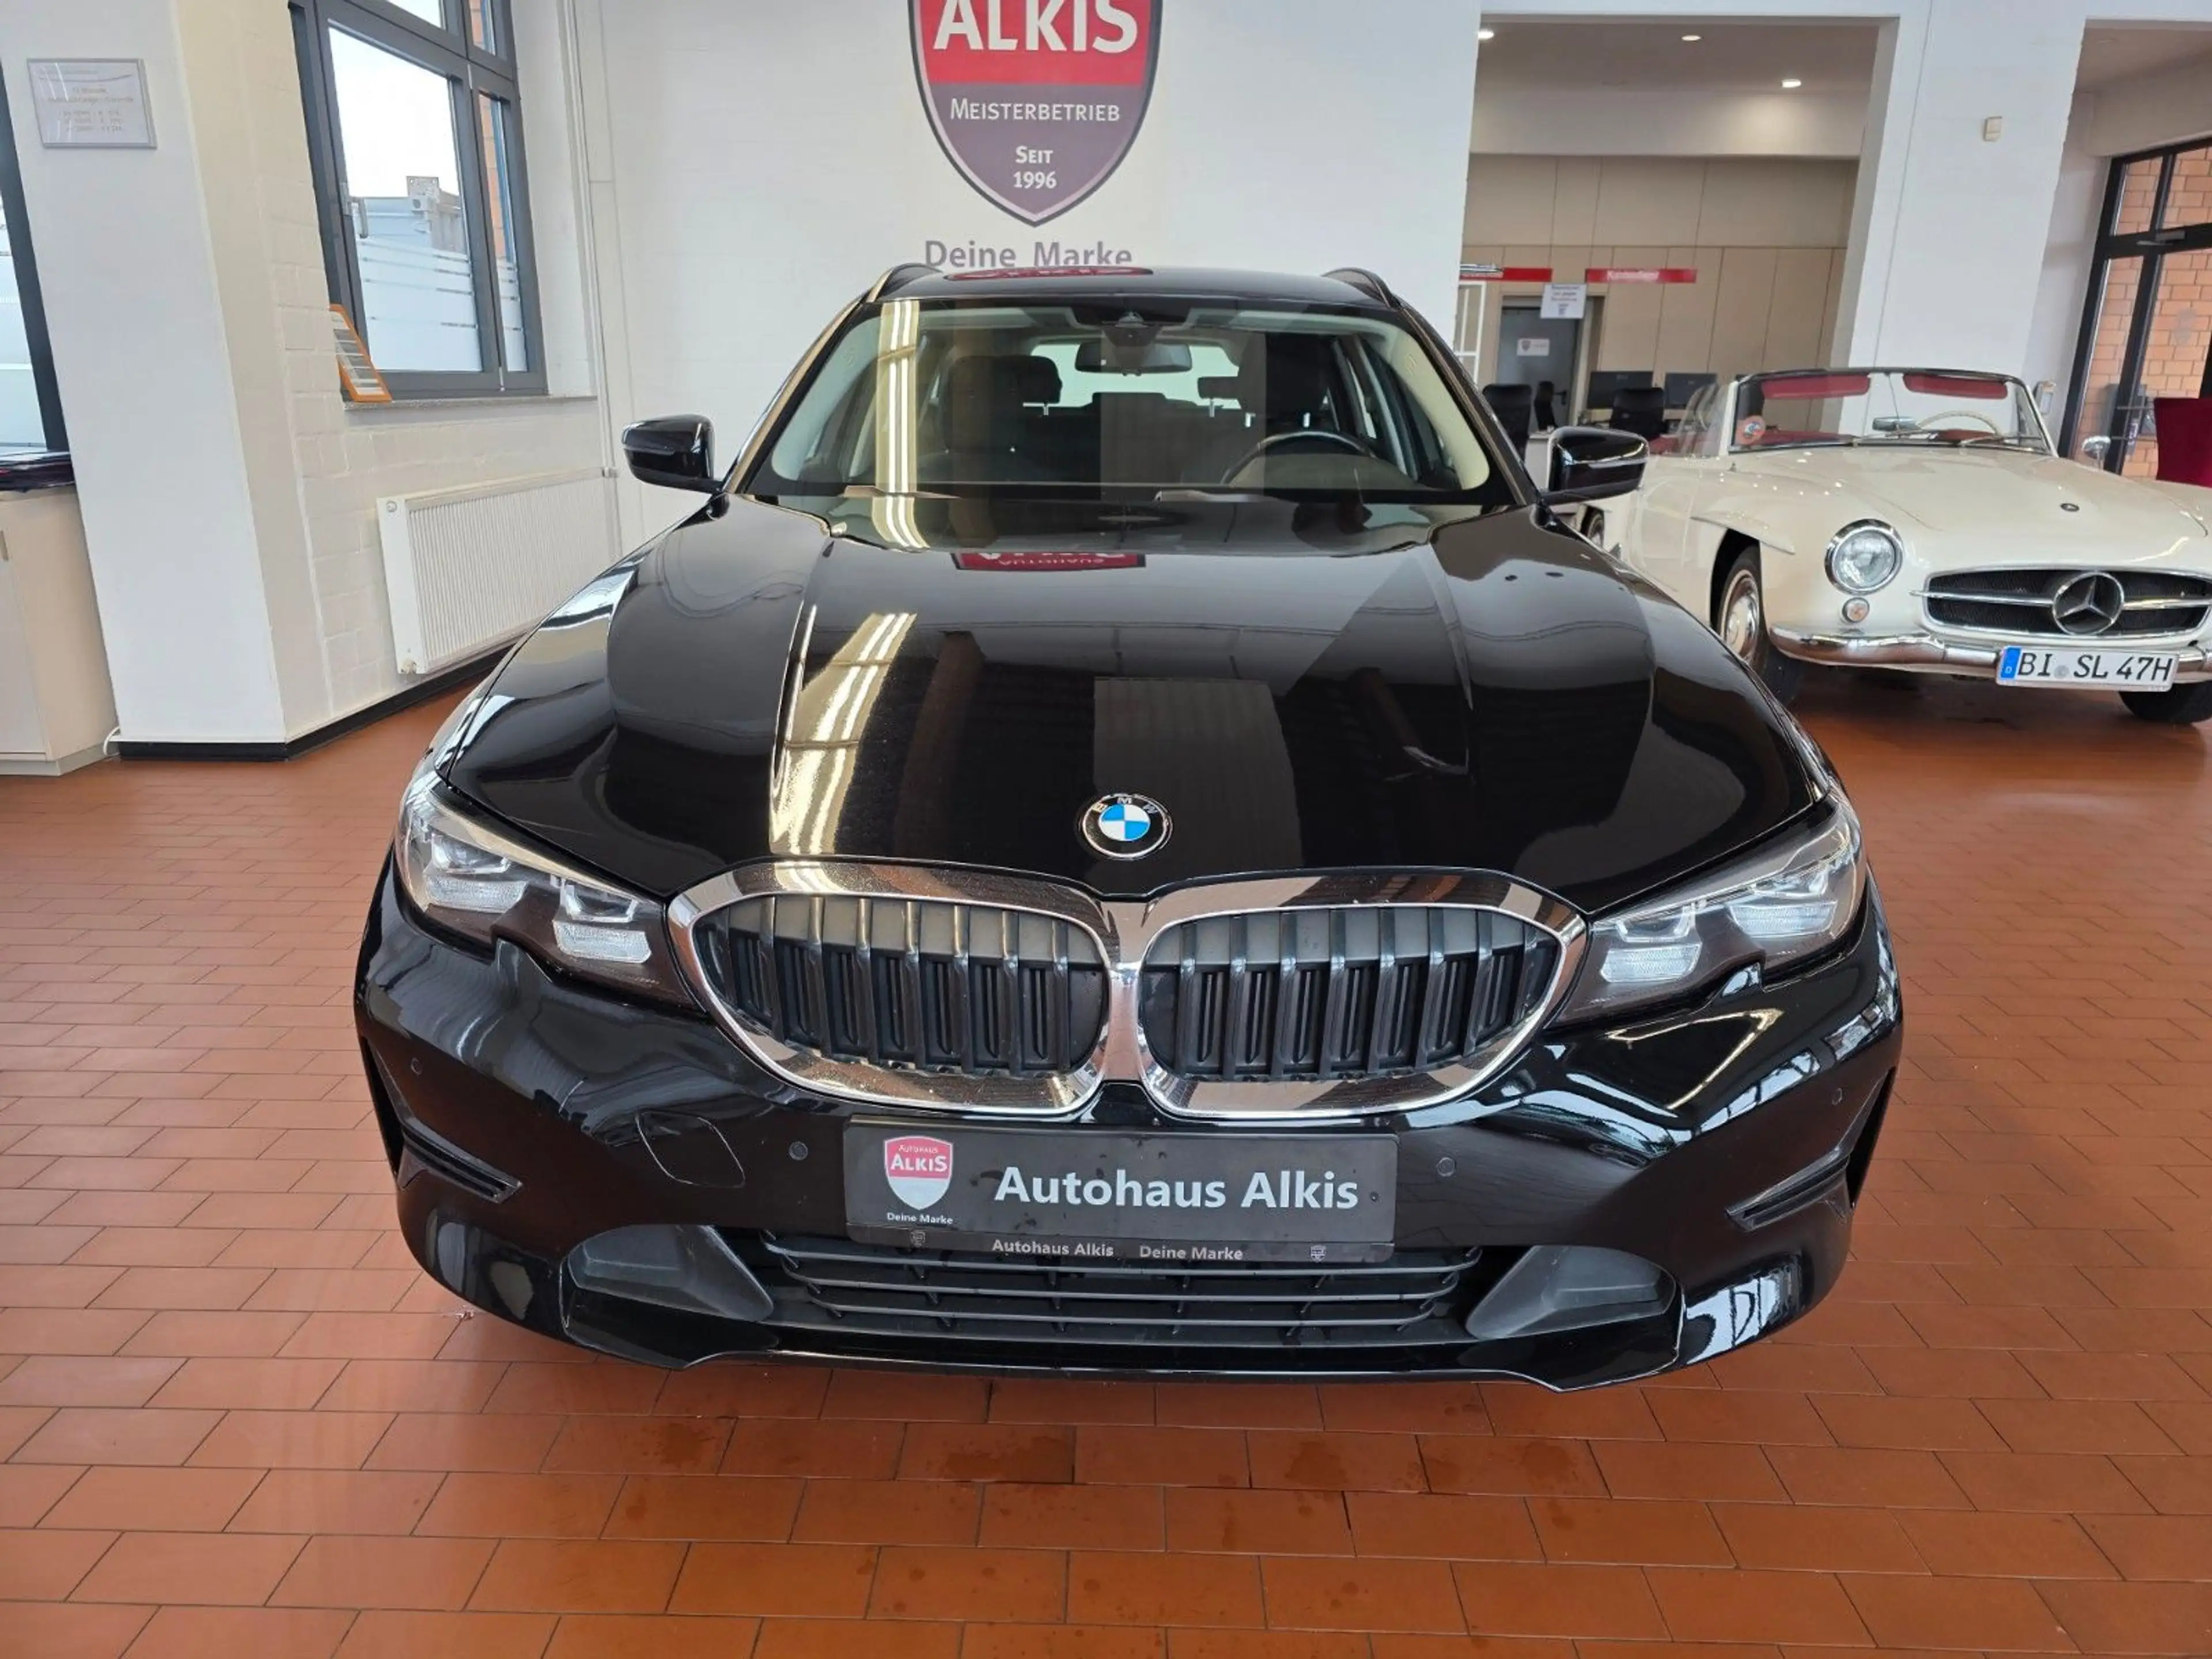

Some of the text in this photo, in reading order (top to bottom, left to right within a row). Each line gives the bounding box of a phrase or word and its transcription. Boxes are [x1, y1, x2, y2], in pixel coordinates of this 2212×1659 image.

[933, 0, 1138, 54] ALKIS
[1013, 172, 1057, 189] 1996
[925, 240, 1132, 268] Deine Marke
[2017, 653, 2053, 677] BI
[2074, 654, 2108, 679] SL
[2116, 656, 2174, 682] 47H
[994, 1166, 1359, 1209] Autohaus Alkis
[887, 1212, 954, 1225] Deine Marke
[992, 1239, 1114, 1256] Autohaus Alkis
[1139, 1245, 1243, 1260] Deine Marke
